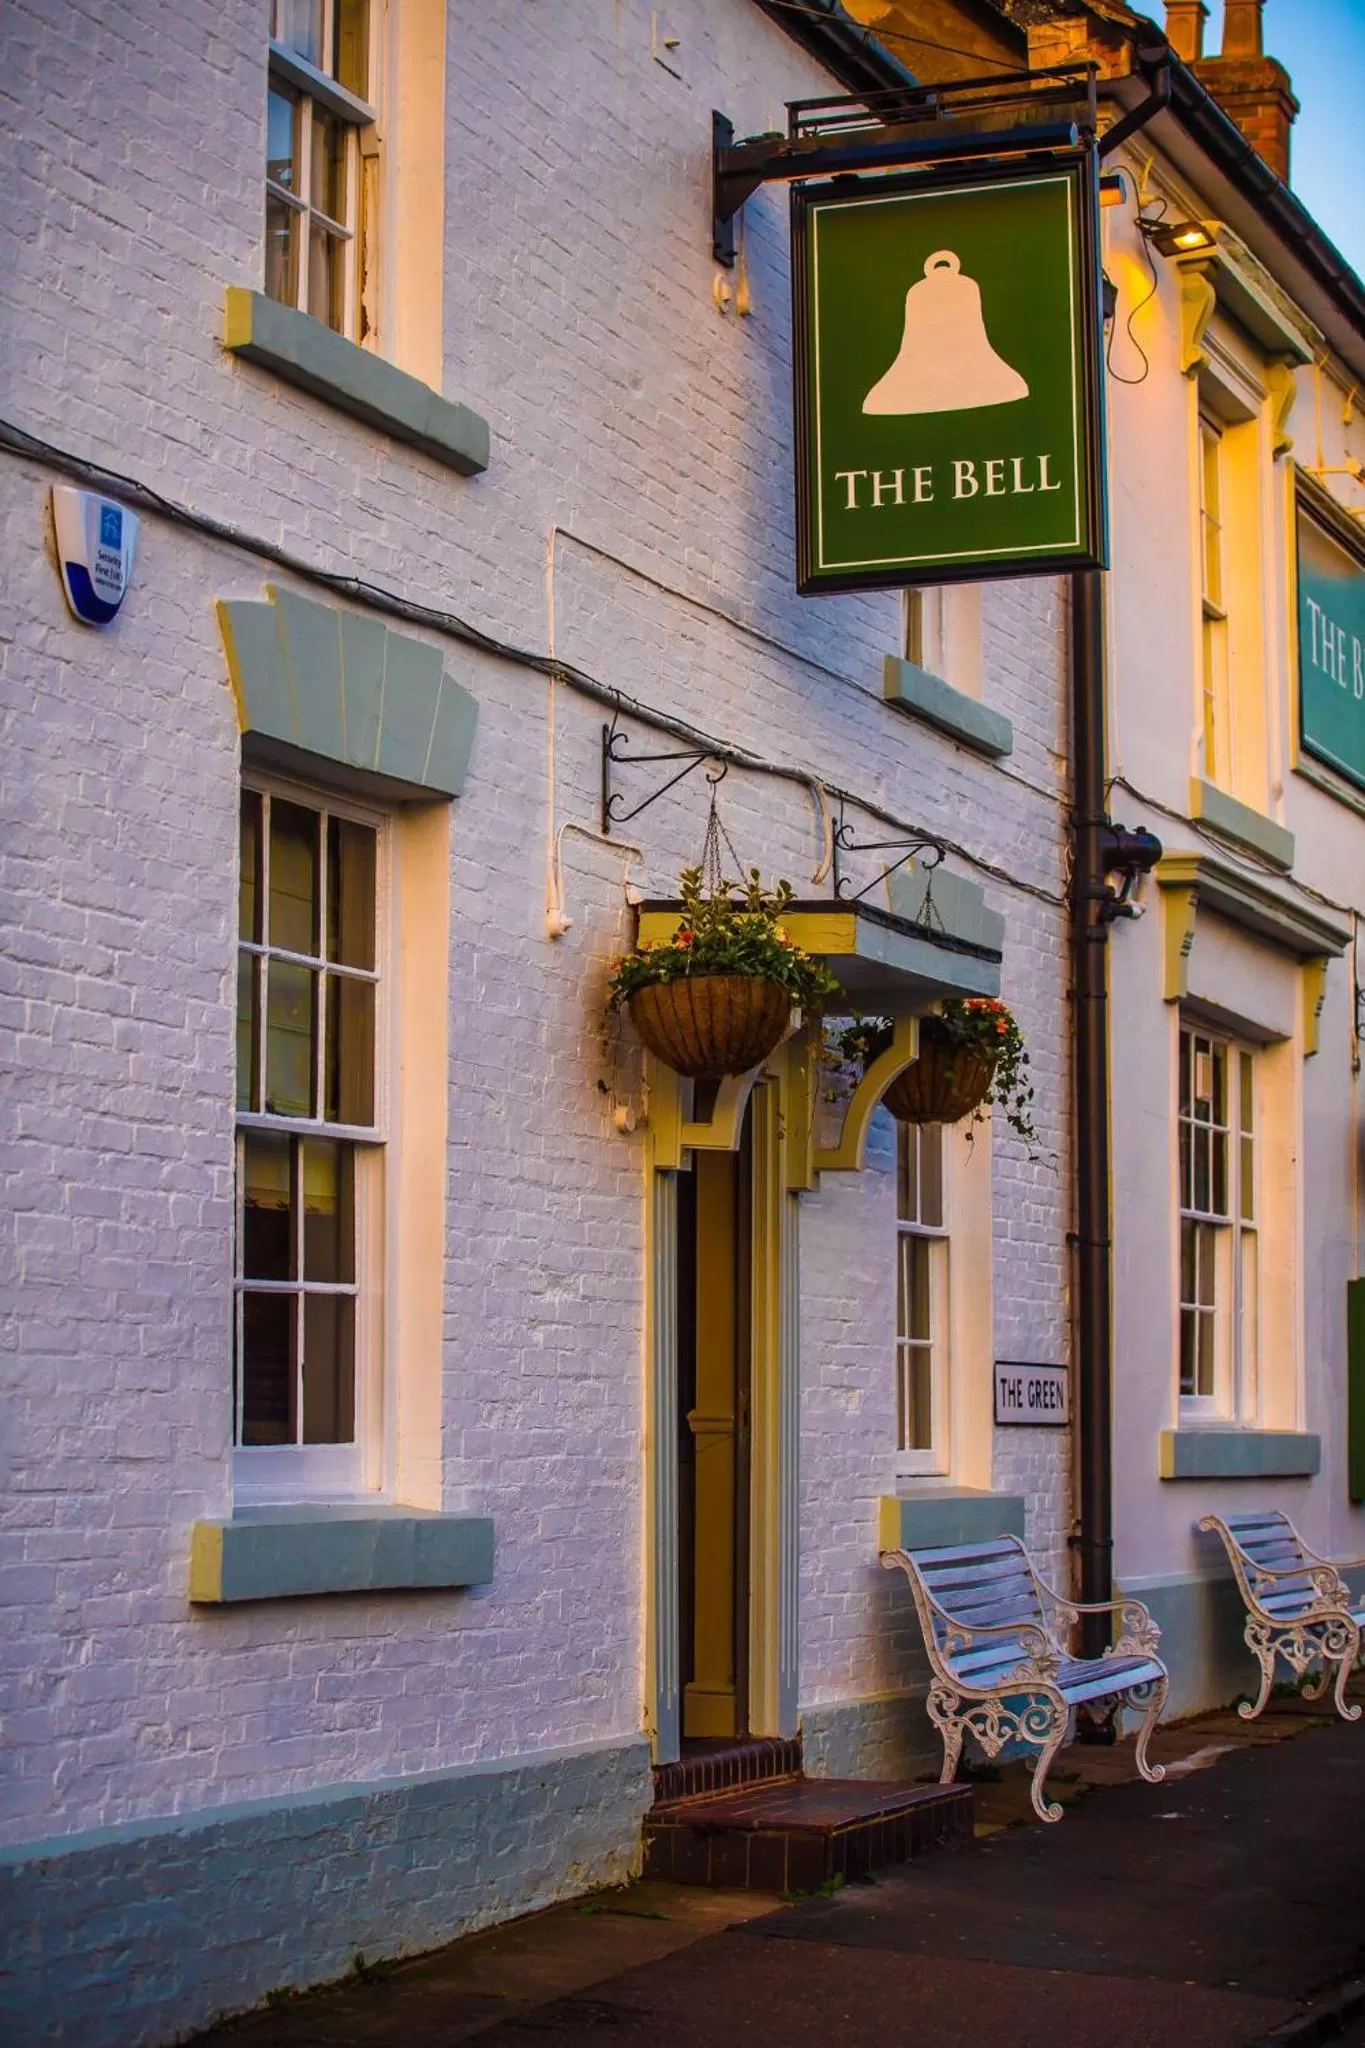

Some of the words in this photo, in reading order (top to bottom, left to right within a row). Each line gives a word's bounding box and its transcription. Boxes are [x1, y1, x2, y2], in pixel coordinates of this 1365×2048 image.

[835, 466, 934, 510] THE
[952, 454, 1061, 500] BELL
[1306, 597, 1347, 688] THE
[1000, 1378, 1023, 1408] THE
[1028, 1379, 1064, 1410] GREEN
